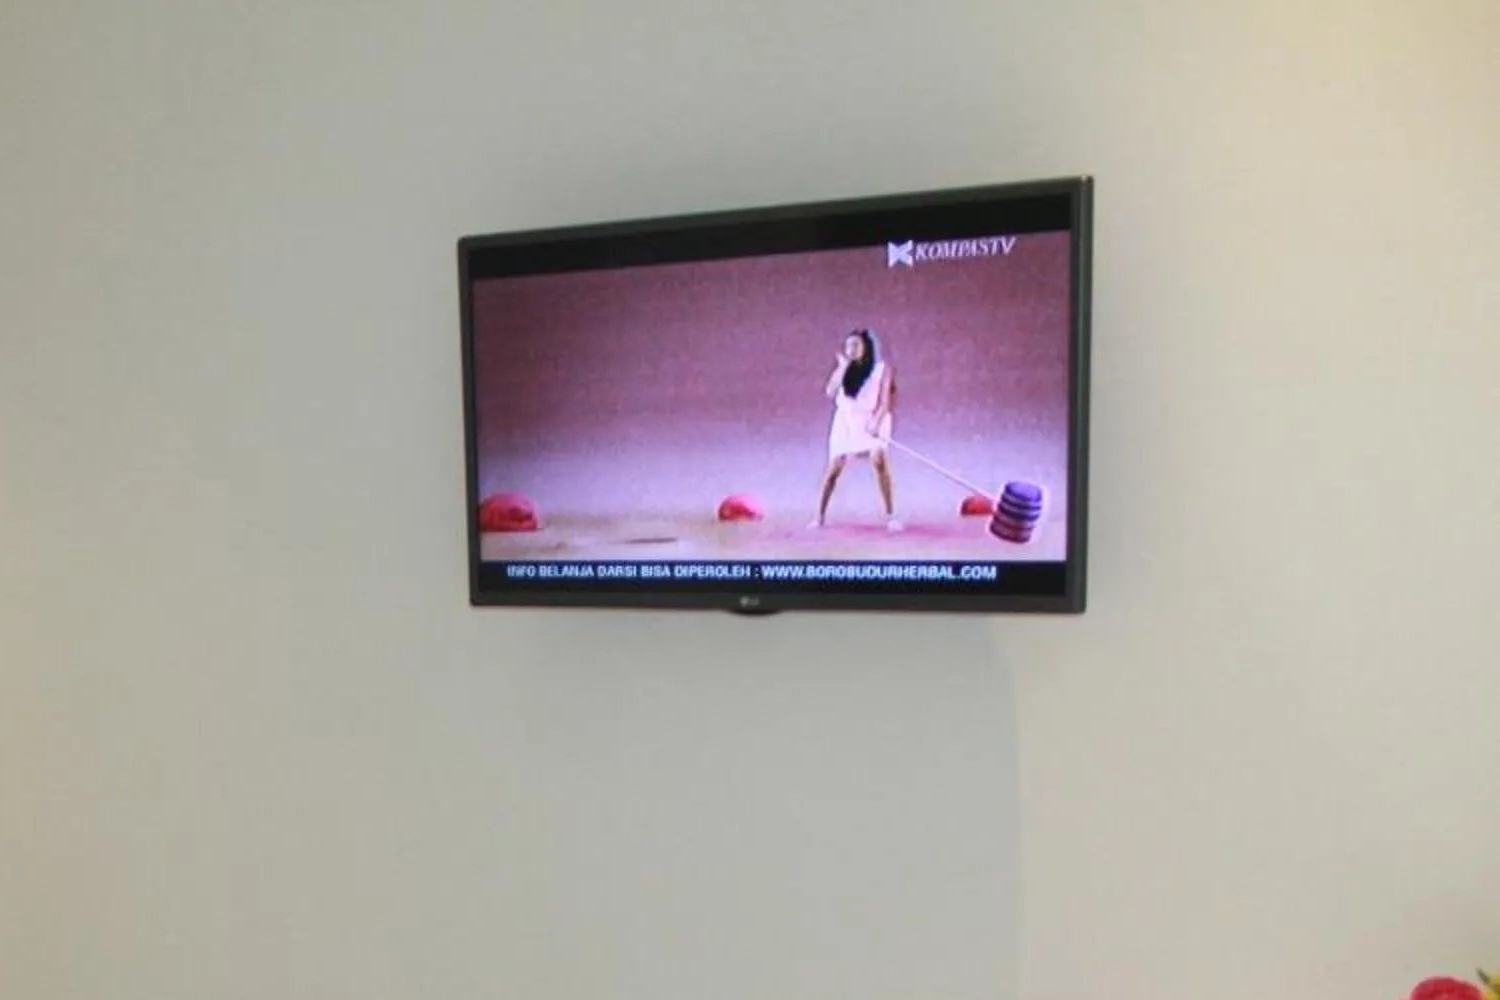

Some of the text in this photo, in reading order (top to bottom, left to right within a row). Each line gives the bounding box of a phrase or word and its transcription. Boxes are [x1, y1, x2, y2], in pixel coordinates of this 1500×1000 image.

[507, 565, 534, 578] INFO
[538, 564, 594, 578] BELANJA
[597, 564, 637, 578] DARSI
[640, 564, 671, 578] BISA
[674, 564, 750, 579] DIPEROLEH
[762, 564, 997, 580] WWW.BOROBUDURHERBAL.COM
